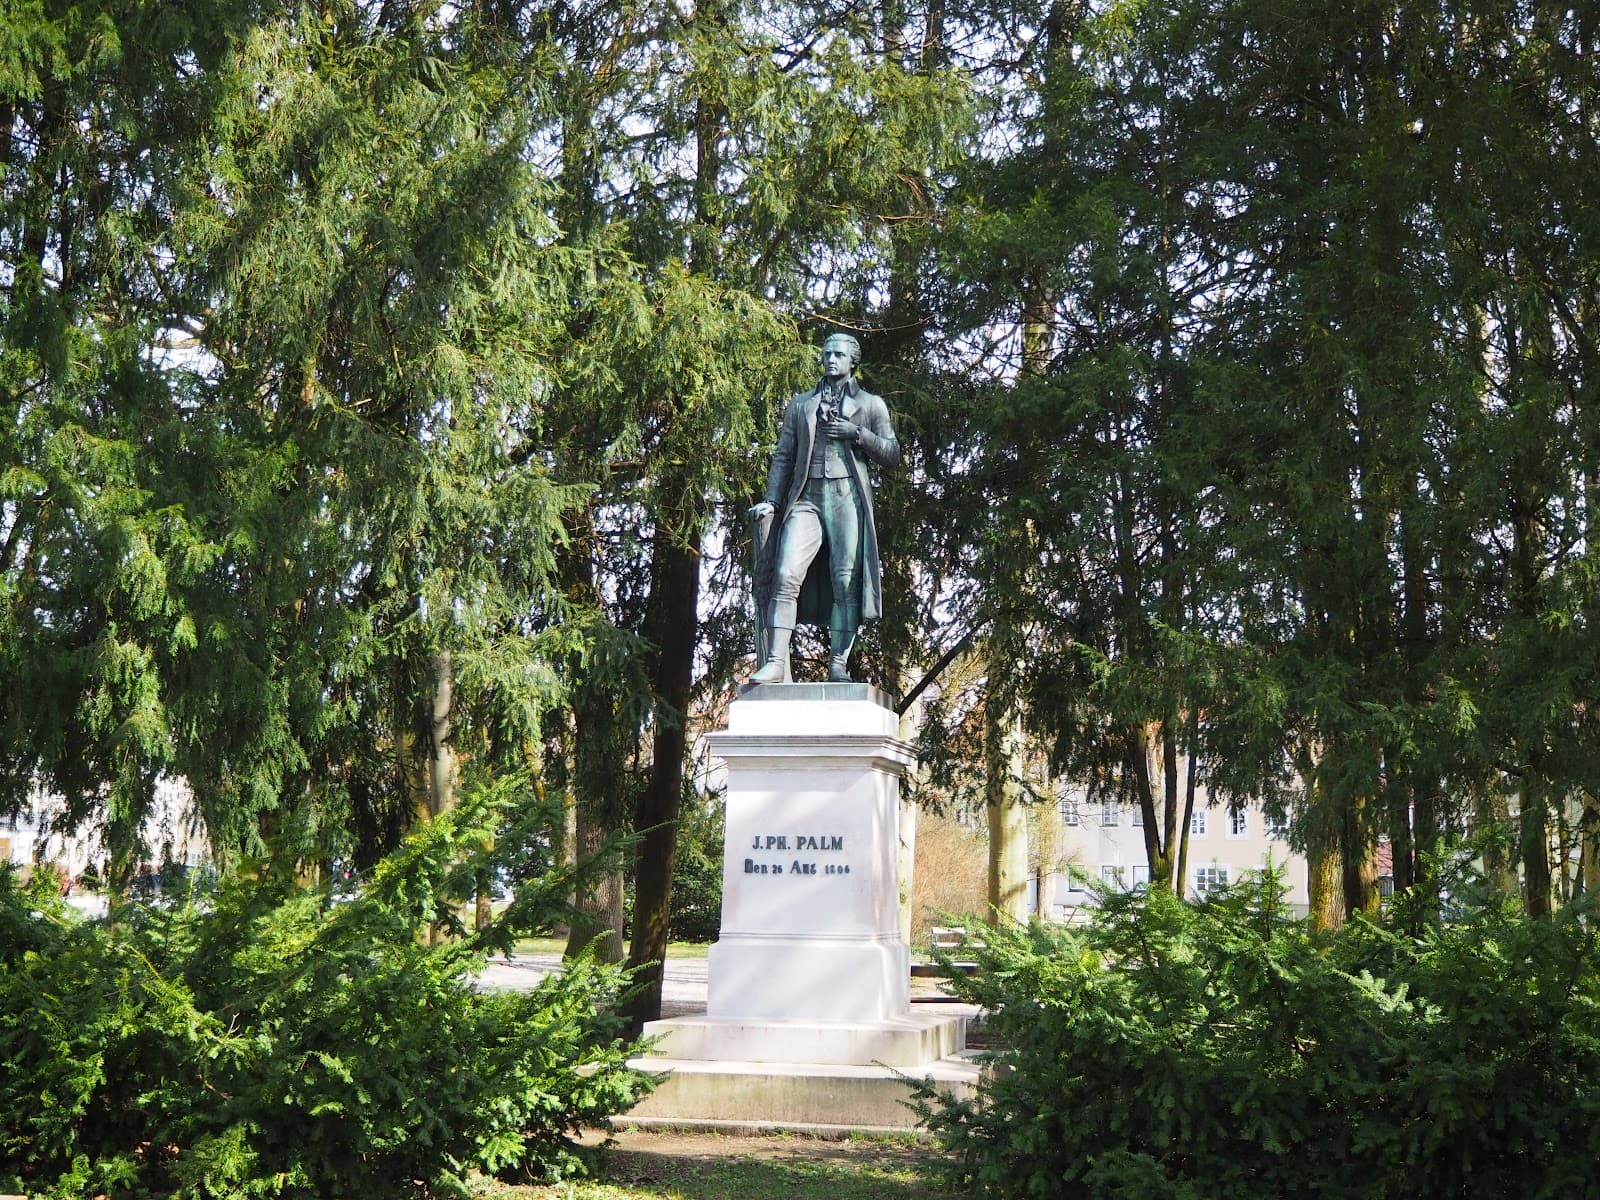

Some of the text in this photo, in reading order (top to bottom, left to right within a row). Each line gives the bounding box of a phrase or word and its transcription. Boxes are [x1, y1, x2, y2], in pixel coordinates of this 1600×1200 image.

[796, 836, 843, 850] PALM
[744, 859, 768, 874] Den
[772, 864, 783, 874] 26
[825, 864, 850, 874] 1806
